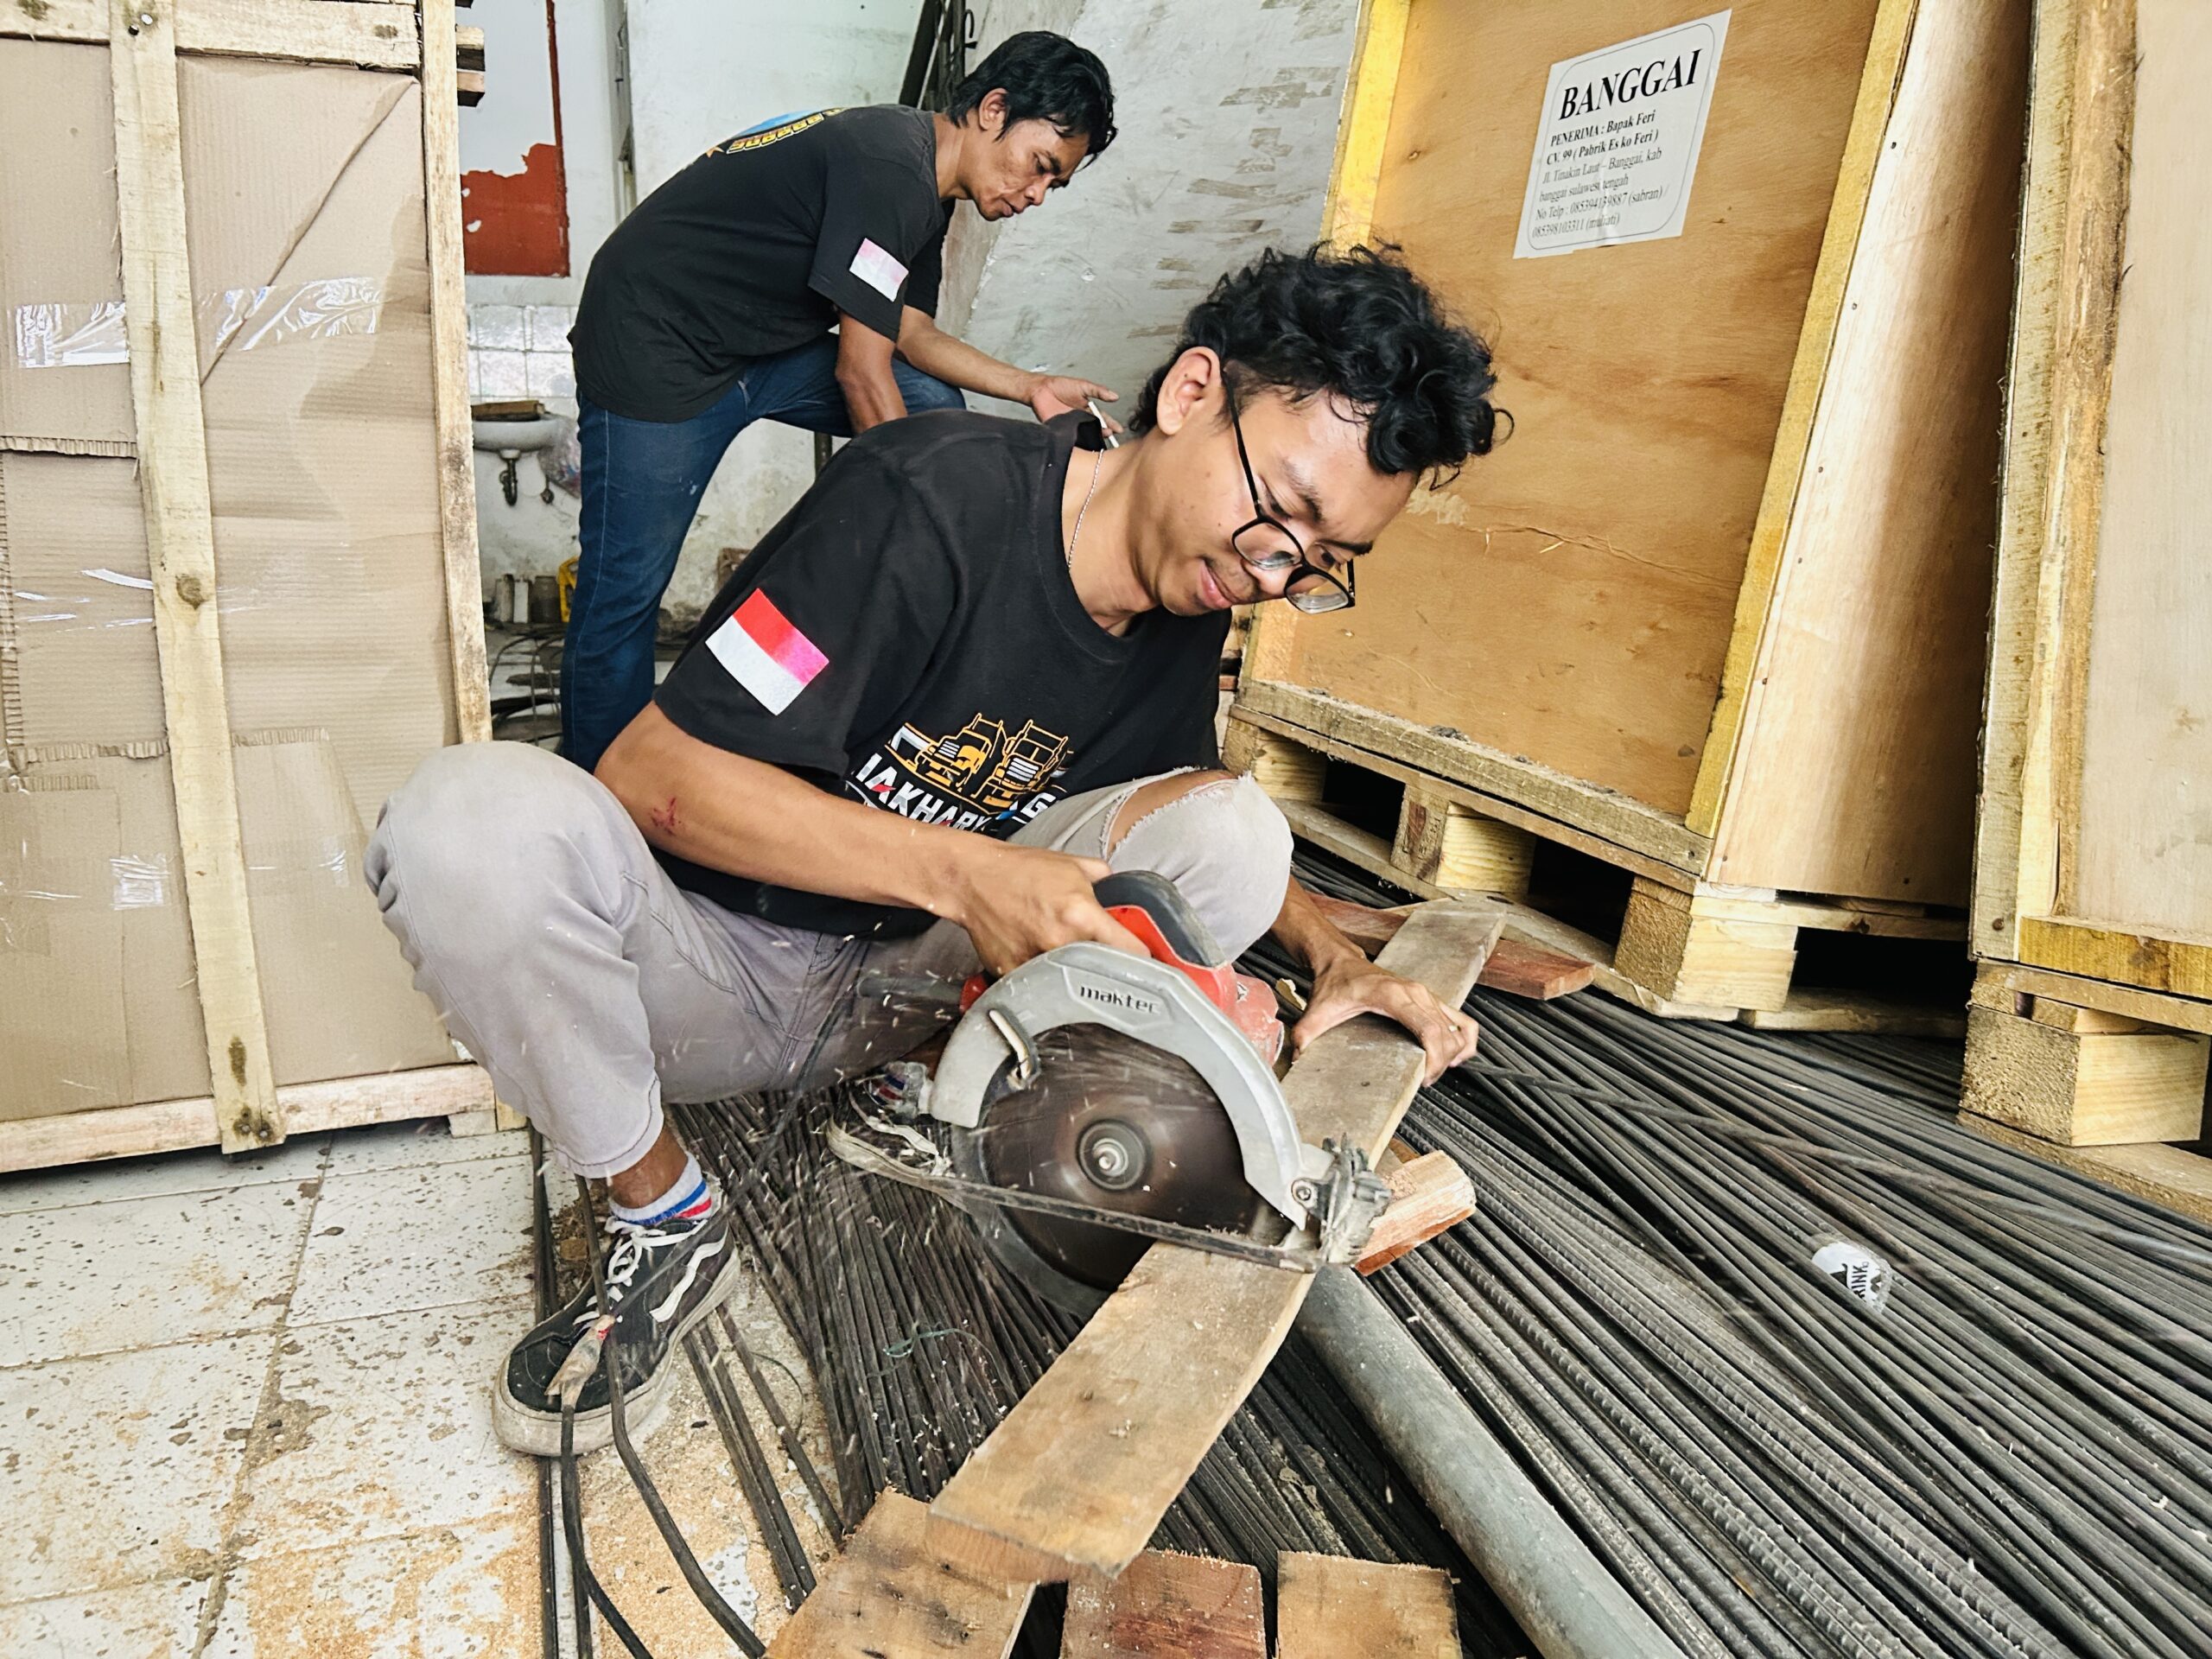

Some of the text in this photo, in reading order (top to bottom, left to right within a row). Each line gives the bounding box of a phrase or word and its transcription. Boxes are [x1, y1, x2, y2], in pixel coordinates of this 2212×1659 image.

[1558, 48, 1703, 120] BANGGAI
[1550, 124, 1599, 147] PENERIMA
[1606, 116, 1633, 133] Bapak
[1636, 109, 1656, 126] Feri
[1547, 152, 1560, 165] CV.
[1562, 150, 1573, 160] 99
[1579, 142, 1605, 157] Pabrik
[1608, 139, 1618, 151] Es
[1620, 136, 1631, 148] ko
[1634, 129, 1654, 145] Feri
[1582, 162, 1599, 175] Laut
[1646, 147, 1662, 162] kab
[1539, 174, 1629, 202] banggai sulawesi tengah
[1535, 209, 1547, 220] No
[1548, 206, 1564, 219] Telp
